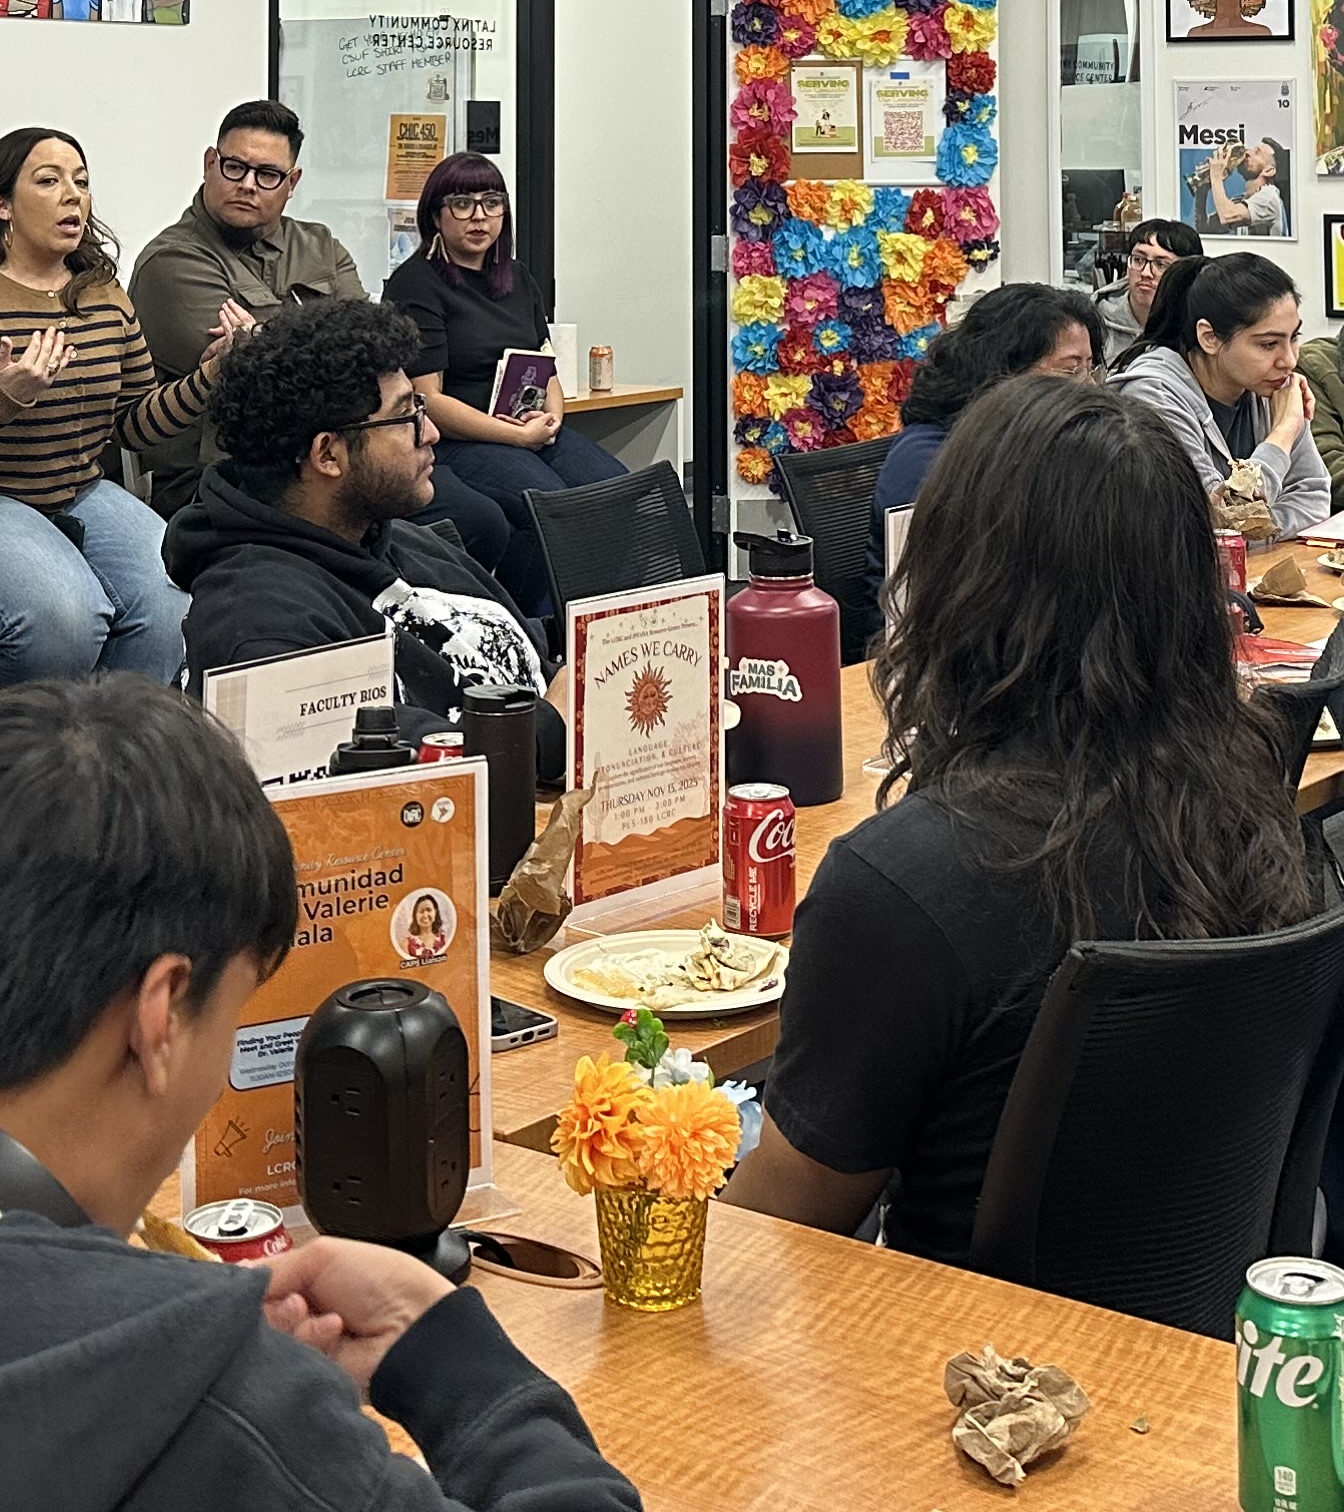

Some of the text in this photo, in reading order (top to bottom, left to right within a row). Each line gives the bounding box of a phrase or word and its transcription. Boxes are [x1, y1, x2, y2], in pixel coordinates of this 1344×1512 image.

[411, 51, 453, 69] MEMBER
[797, 80, 850, 88] SERVING
[876, 89, 929, 98] SERVING
[1277, 99, 1290, 108] 10
[399, 122, 436, 138] CHIC 450
[1178, 123, 1245, 145] Messi
[594, 640, 702, 690] NAMES WE CARRY
[748, 662, 775, 676] MAS
[732, 673, 798, 697] FAMILIA
[300, 685, 387, 717] FACULTY BIOS
[668, 742, 701, 757] CULTURE
[600, 791, 645, 813] THURSDAY
[647, 786, 666, 801] NOV
[678, 777, 698, 792] 2025
[633, 805, 645, 816] PM
[674, 794, 686, 805] PM
[296, 863, 404, 899] munidad
[303, 890, 389, 921] Valerie
[748, 866, 758, 931] RECYCLE ME
[293, 924, 333, 947] ala
[400, 959, 420, 970] CAPS
[262, 1128, 296, 1154] Join
[255, 1182, 278, 1192] more
[1235, 1320, 1324, 1408] ite
